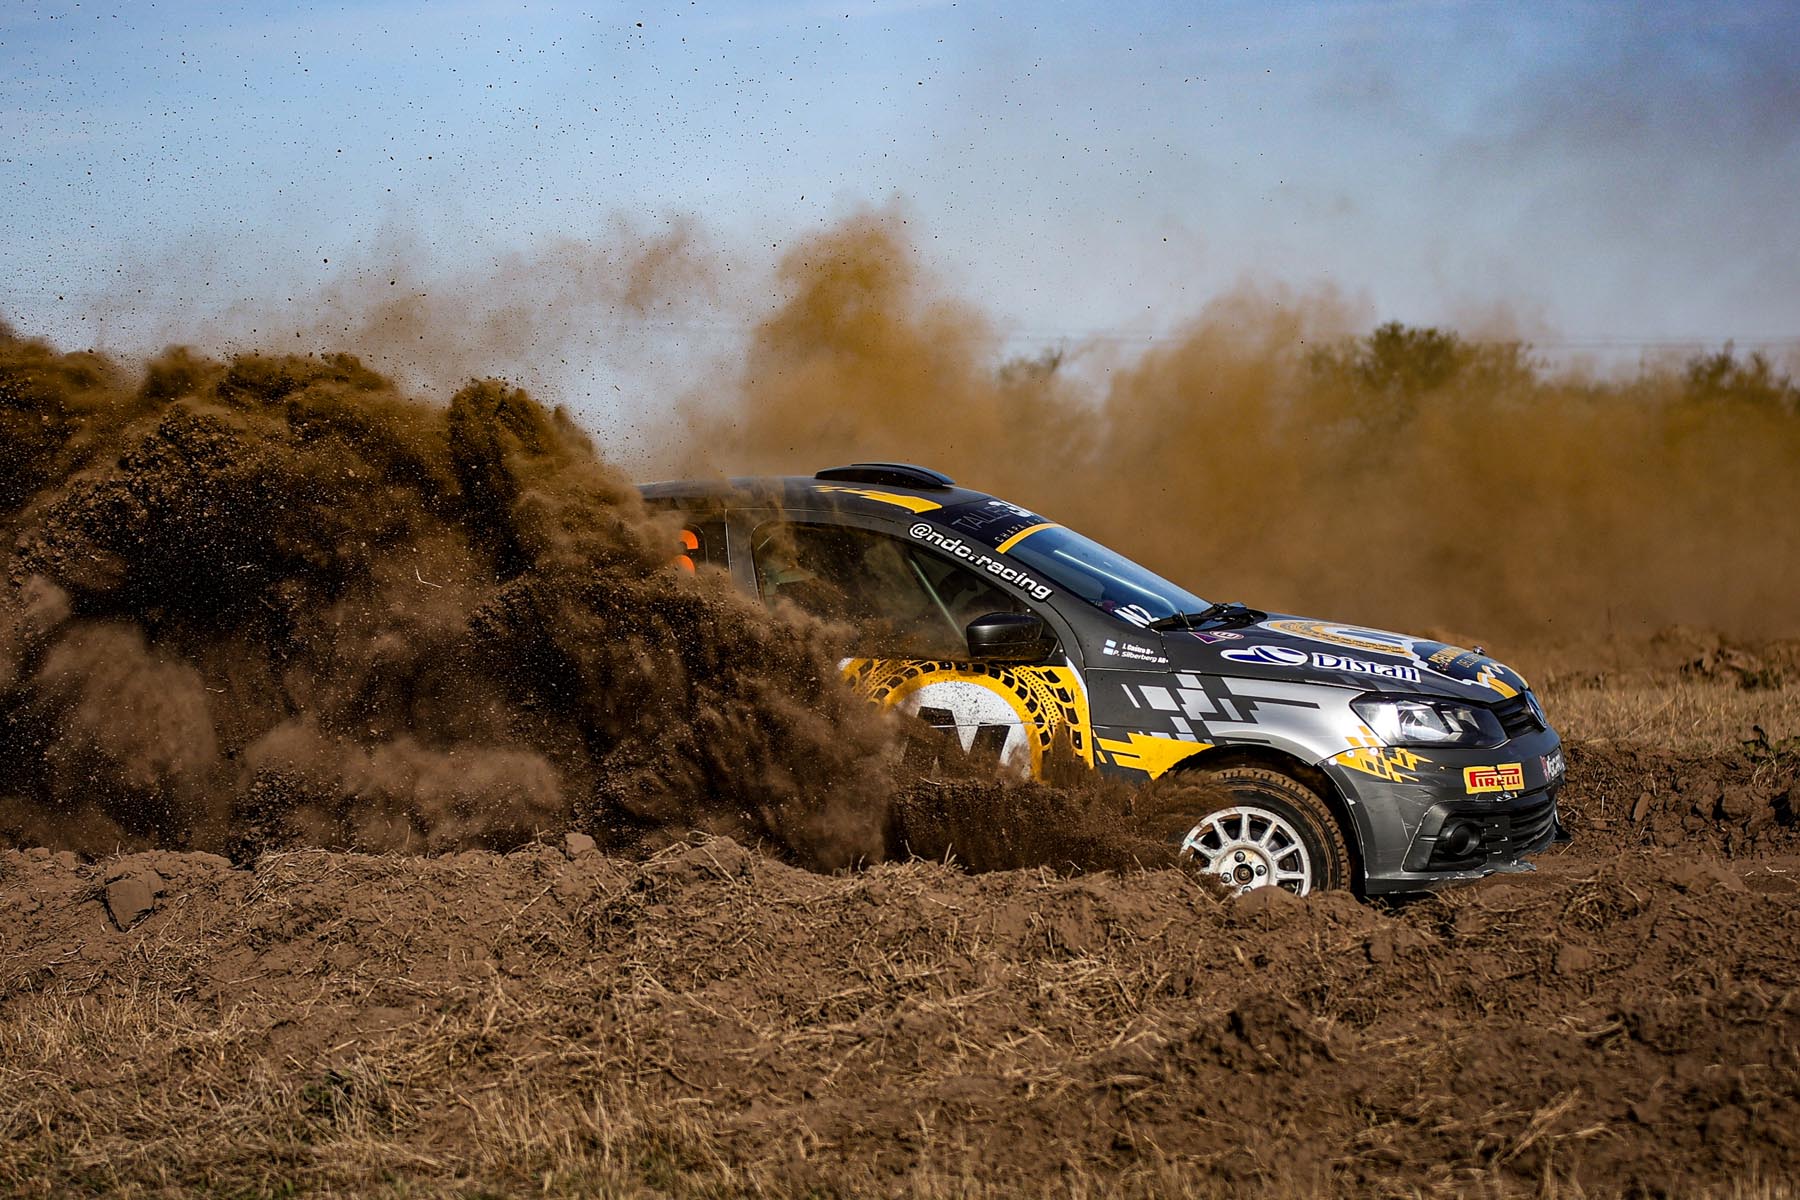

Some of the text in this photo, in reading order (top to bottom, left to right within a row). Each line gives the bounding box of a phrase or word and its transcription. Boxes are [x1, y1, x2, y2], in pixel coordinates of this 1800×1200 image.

[909, 523, 1053, 600] @ndc.racing
[1121, 651, 1158, 663] Silberberg
[1315, 652, 1419, 682] Distall
[1469, 768, 1520, 788] PIRELLI
